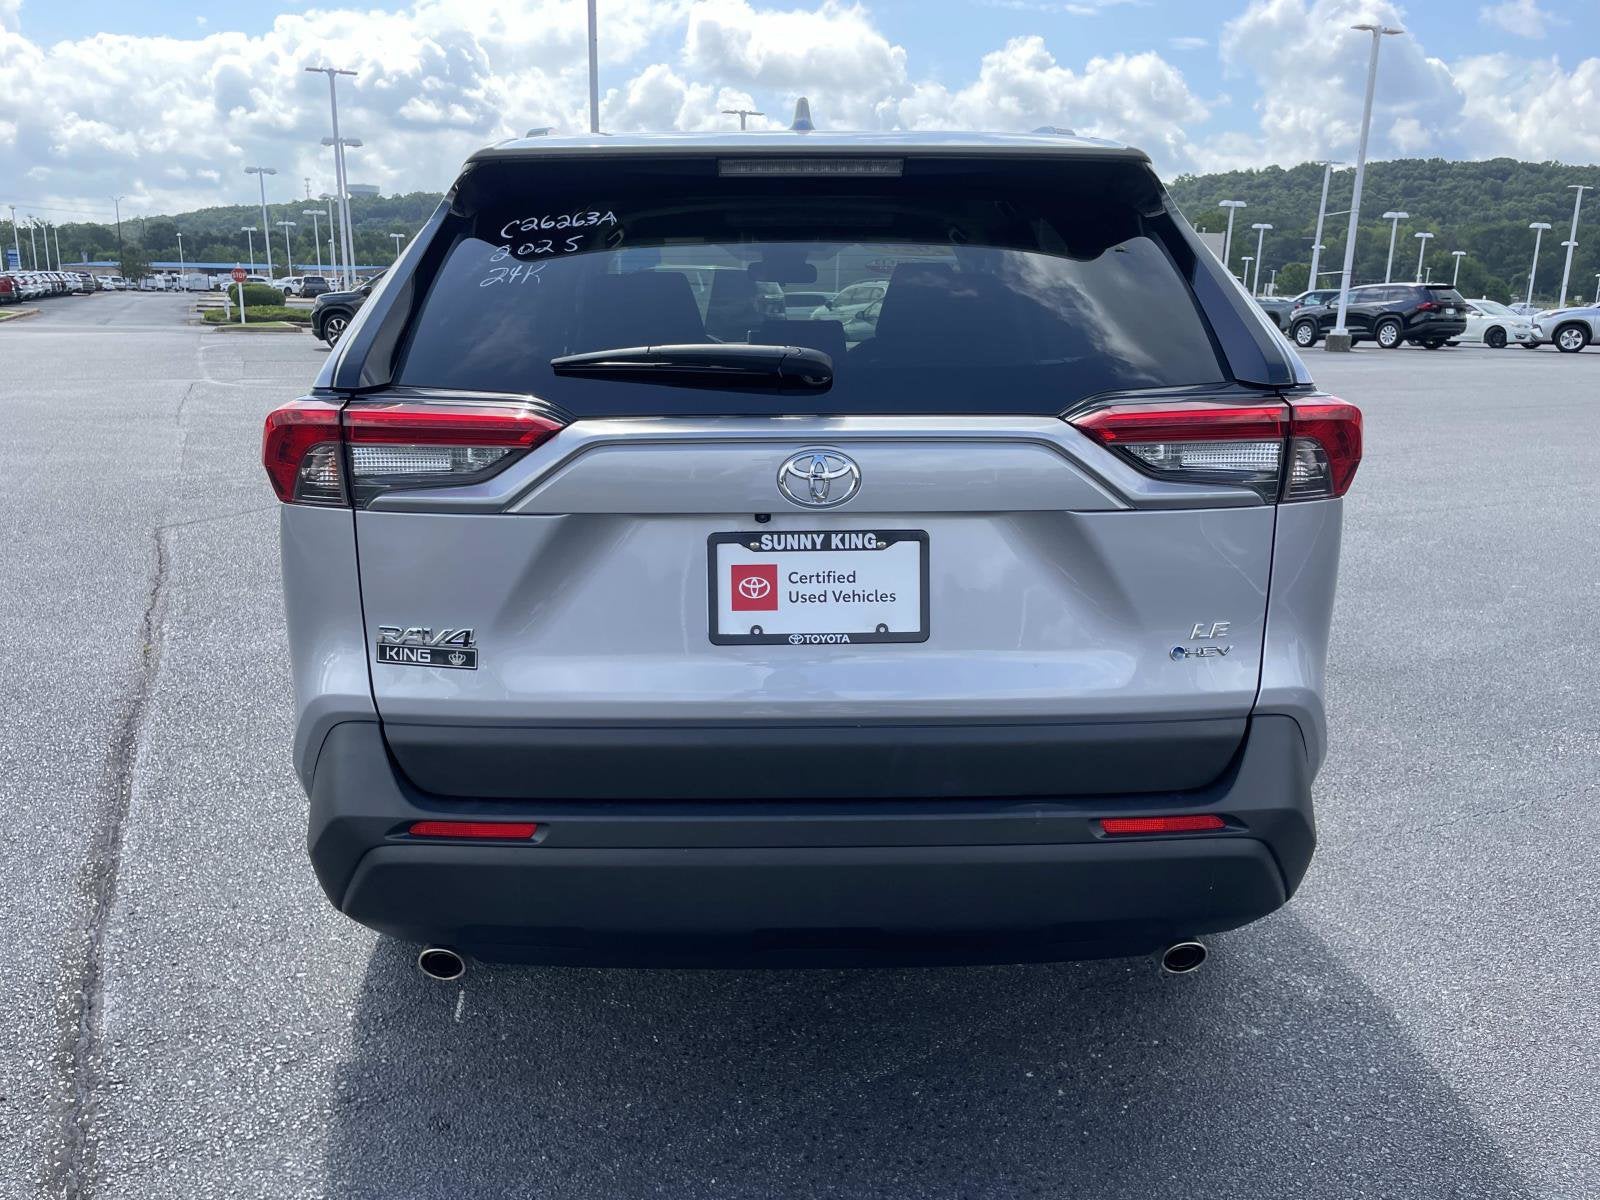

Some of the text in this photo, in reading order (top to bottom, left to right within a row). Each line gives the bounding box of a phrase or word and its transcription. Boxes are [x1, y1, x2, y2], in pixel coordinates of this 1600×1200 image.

[500, 211, 617, 239] C26263A
[490, 235, 584, 262] 2025
[231, 271, 246, 279] STOP
[480, 264, 546, 287] 24K
[760, 533, 877, 551] SUNNY KING
[788, 570, 857, 585] Certified
[788, 589, 897, 604] Used Vehicles
[377, 625, 476, 649] RAV4
[1190, 621, 1231, 640] LE
[804, 634, 851, 645] TOYOTA
[386, 646, 431, 663] KING
[1185, 644, 1234, 659] HEV
